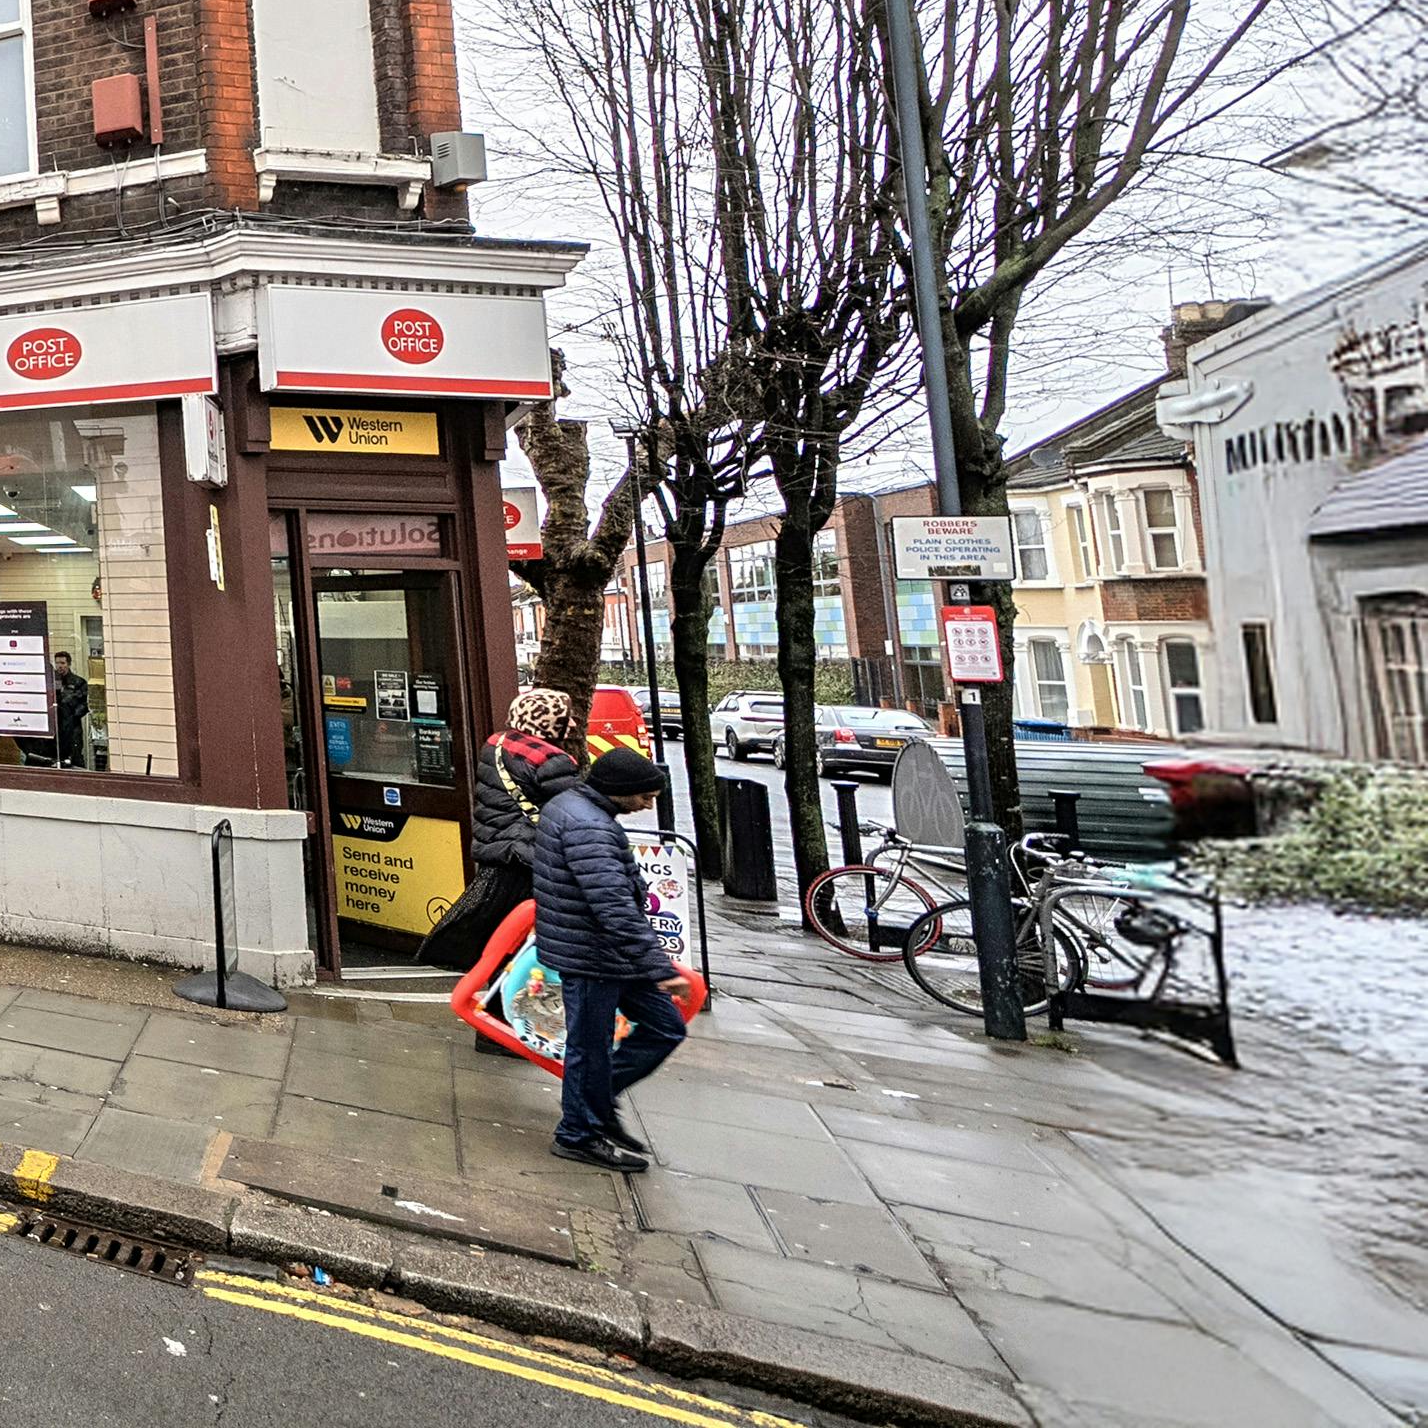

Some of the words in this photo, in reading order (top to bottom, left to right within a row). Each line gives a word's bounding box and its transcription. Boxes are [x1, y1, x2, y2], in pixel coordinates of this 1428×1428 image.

[394, 321, 432, 336] POST
[22, 337, 68, 355] POST
[388, 337, 438, 353] OFFICE
[14, 352, 75, 371] OFFICE
[347, 416, 403, 432] Western
[348, 432, 388, 446] Union
[922, 520, 978, 528] ROBBERS
[362, 816, 394, 829] Western
[363, 824, 386, 835] Union
[342, 846, 381, 864] Send
[384, 857, 414, 870] and
[344, 864, 400, 884] receive
[345, 881, 396, 902] money
[346, 895, 381, 913] here
